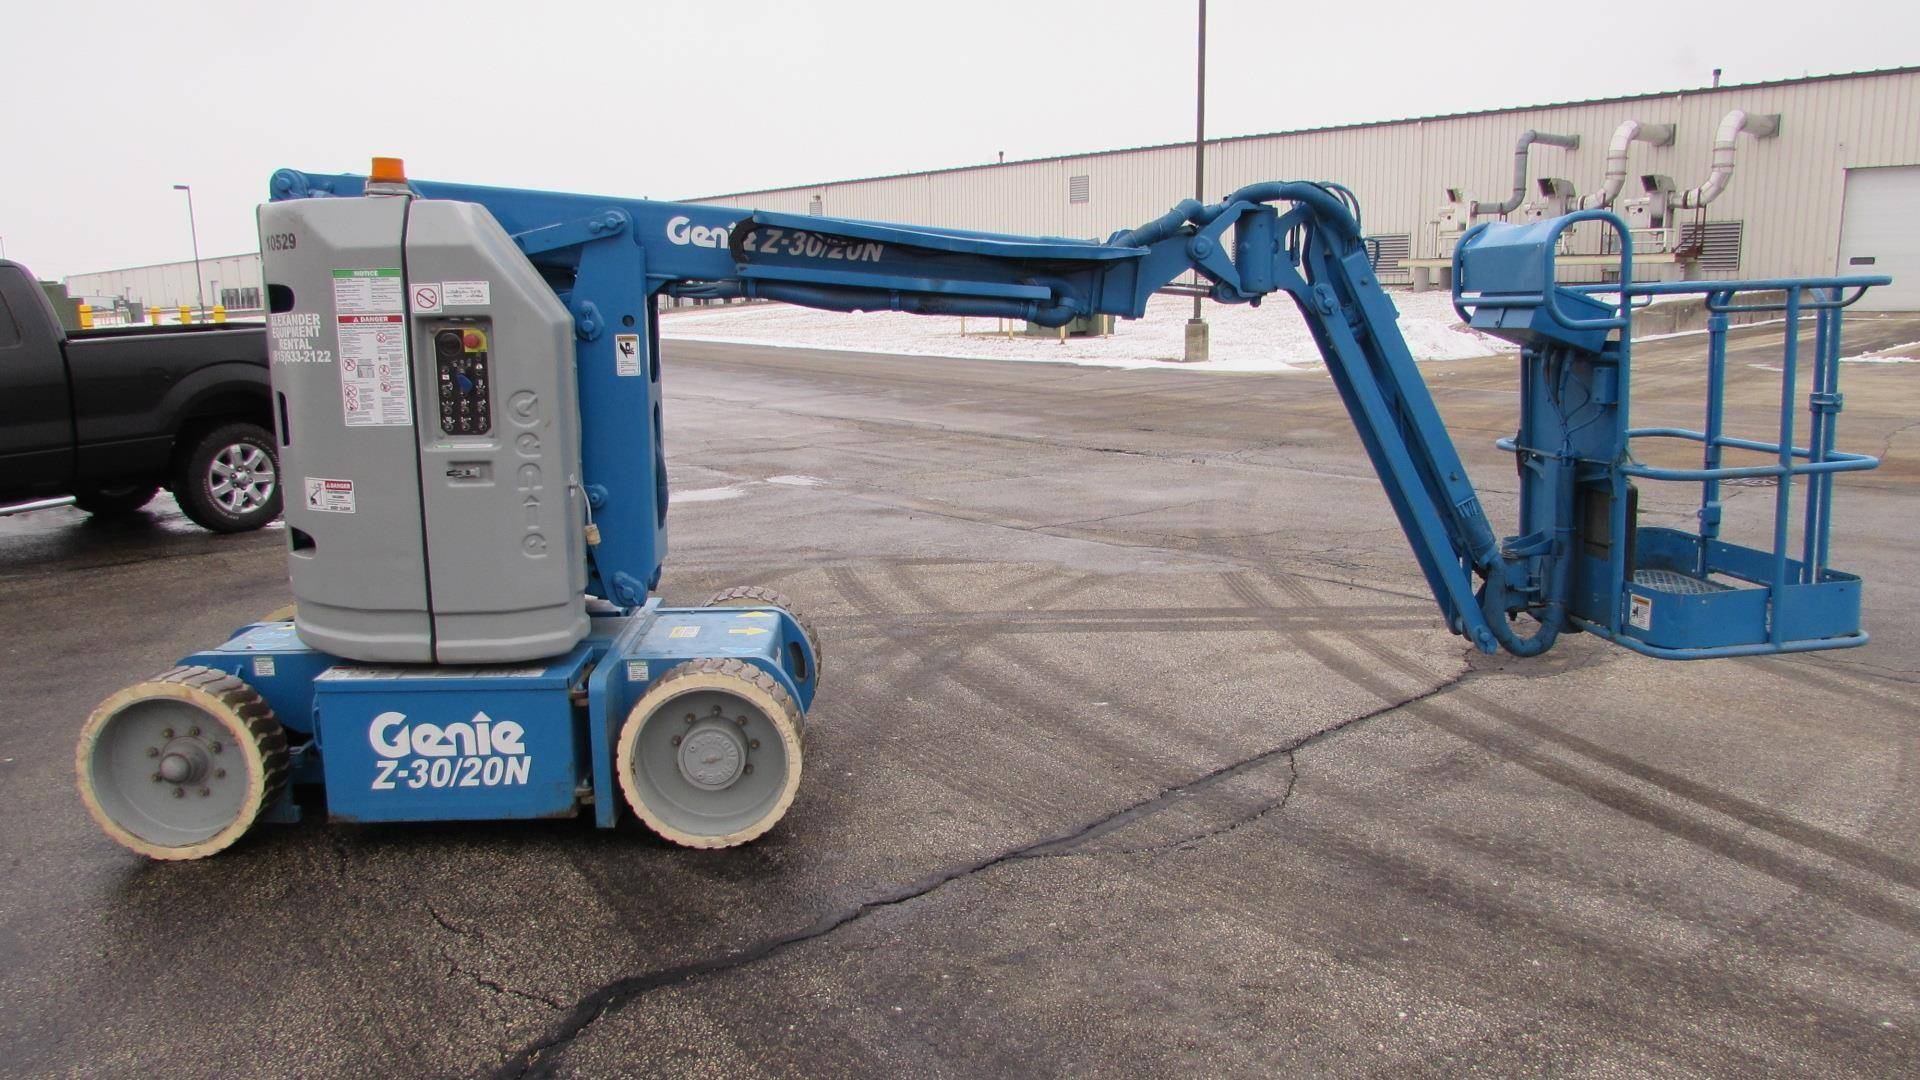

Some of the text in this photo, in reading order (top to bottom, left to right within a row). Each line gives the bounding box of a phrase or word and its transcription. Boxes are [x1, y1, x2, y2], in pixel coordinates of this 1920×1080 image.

[267, 233, 296, 251] 10529
[272, 325, 321, 338] EQUIPMENT
[279, 338, 313, 350] RENTAL
[369, 711, 525, 758] Genie
[371, 755, 532, 790] Z-30/20N
